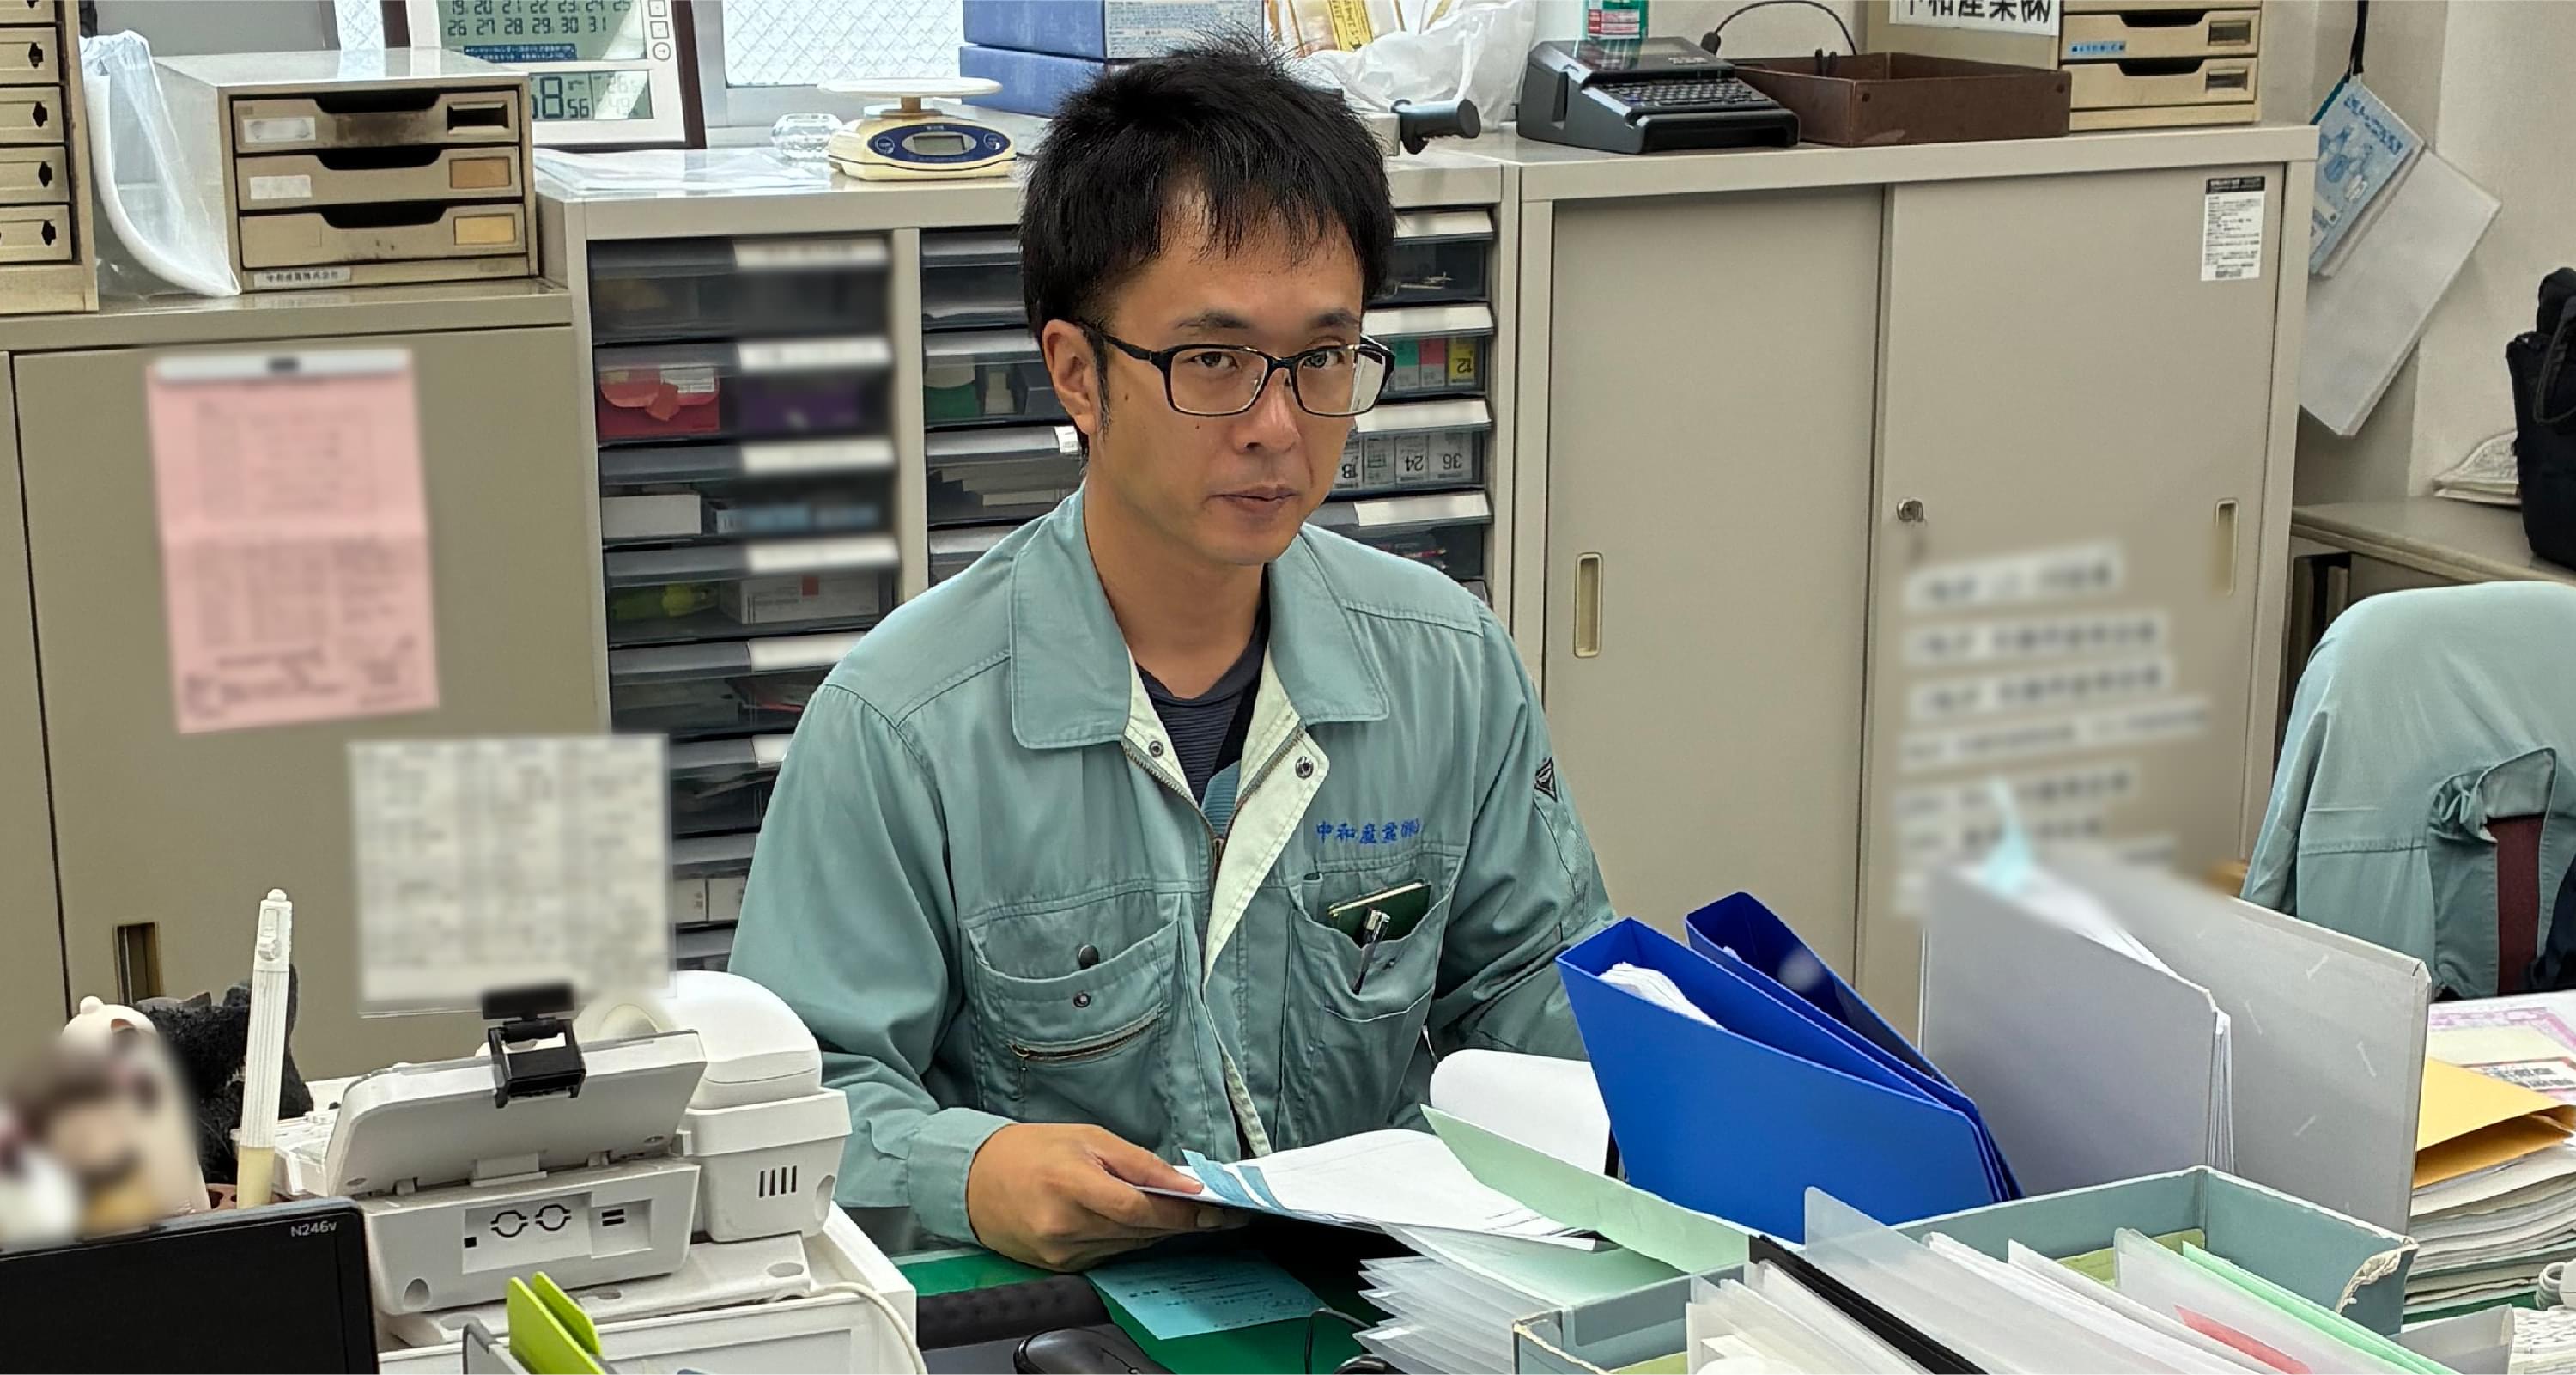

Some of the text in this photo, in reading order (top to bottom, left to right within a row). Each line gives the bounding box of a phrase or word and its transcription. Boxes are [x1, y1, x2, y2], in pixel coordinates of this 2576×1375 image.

[447, 16, 606, 36] 26 27 28 29 30 31
[531, 76, 589, 119] 8 56
[1403, 455, 1424, 472] 24
[1443, 453, 1463, 470] 36
[290, 1220, 337, 1238] N246v
